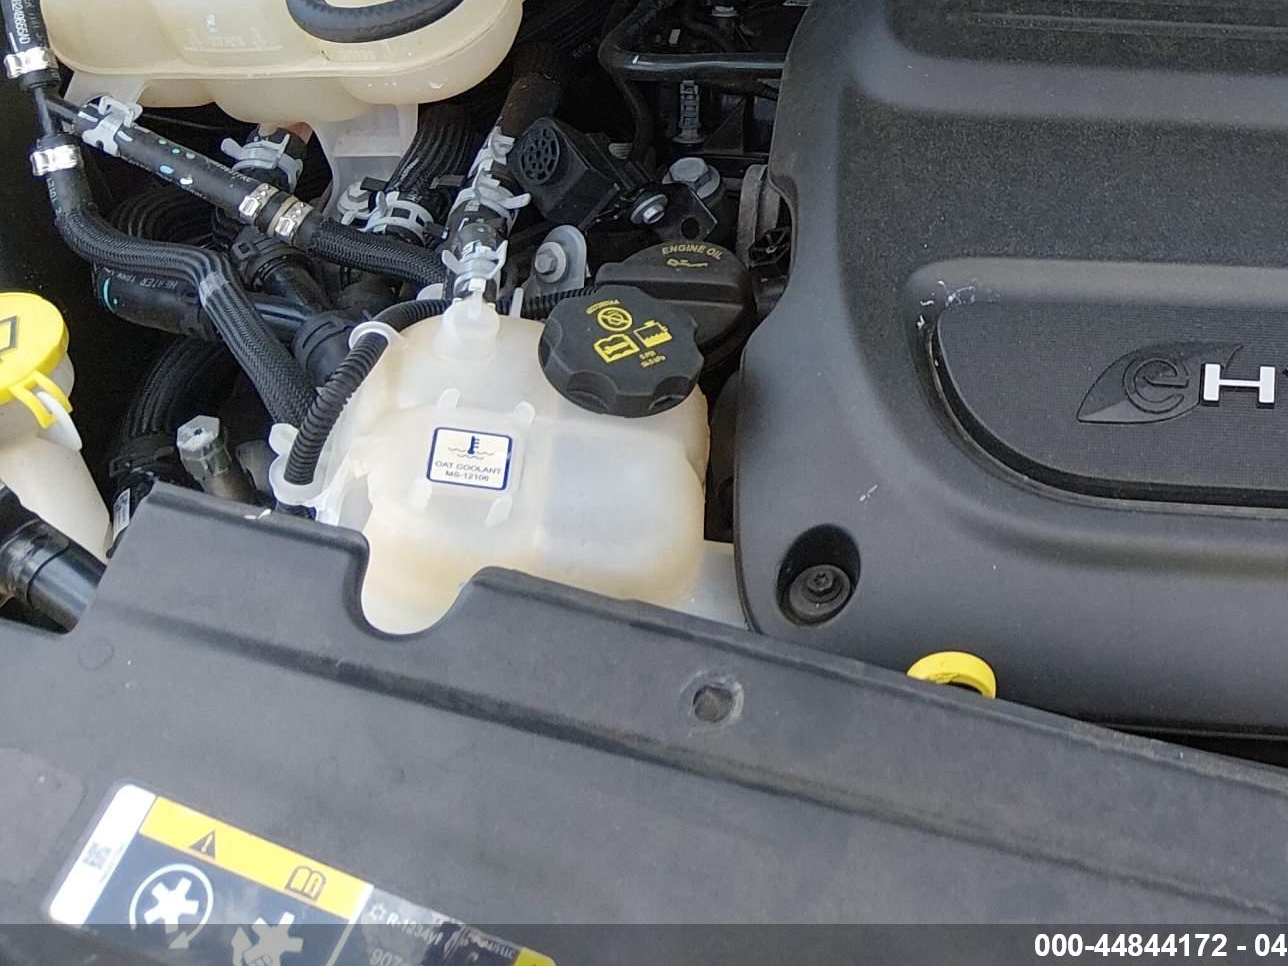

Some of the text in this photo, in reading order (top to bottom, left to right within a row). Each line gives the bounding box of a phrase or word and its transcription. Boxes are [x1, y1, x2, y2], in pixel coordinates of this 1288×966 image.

[661, 243, 724, 261] ENGINE OIL
[435, 460, 502, 475] OAT COOLANT
[386, 912, 444, 946] R-1234yf
